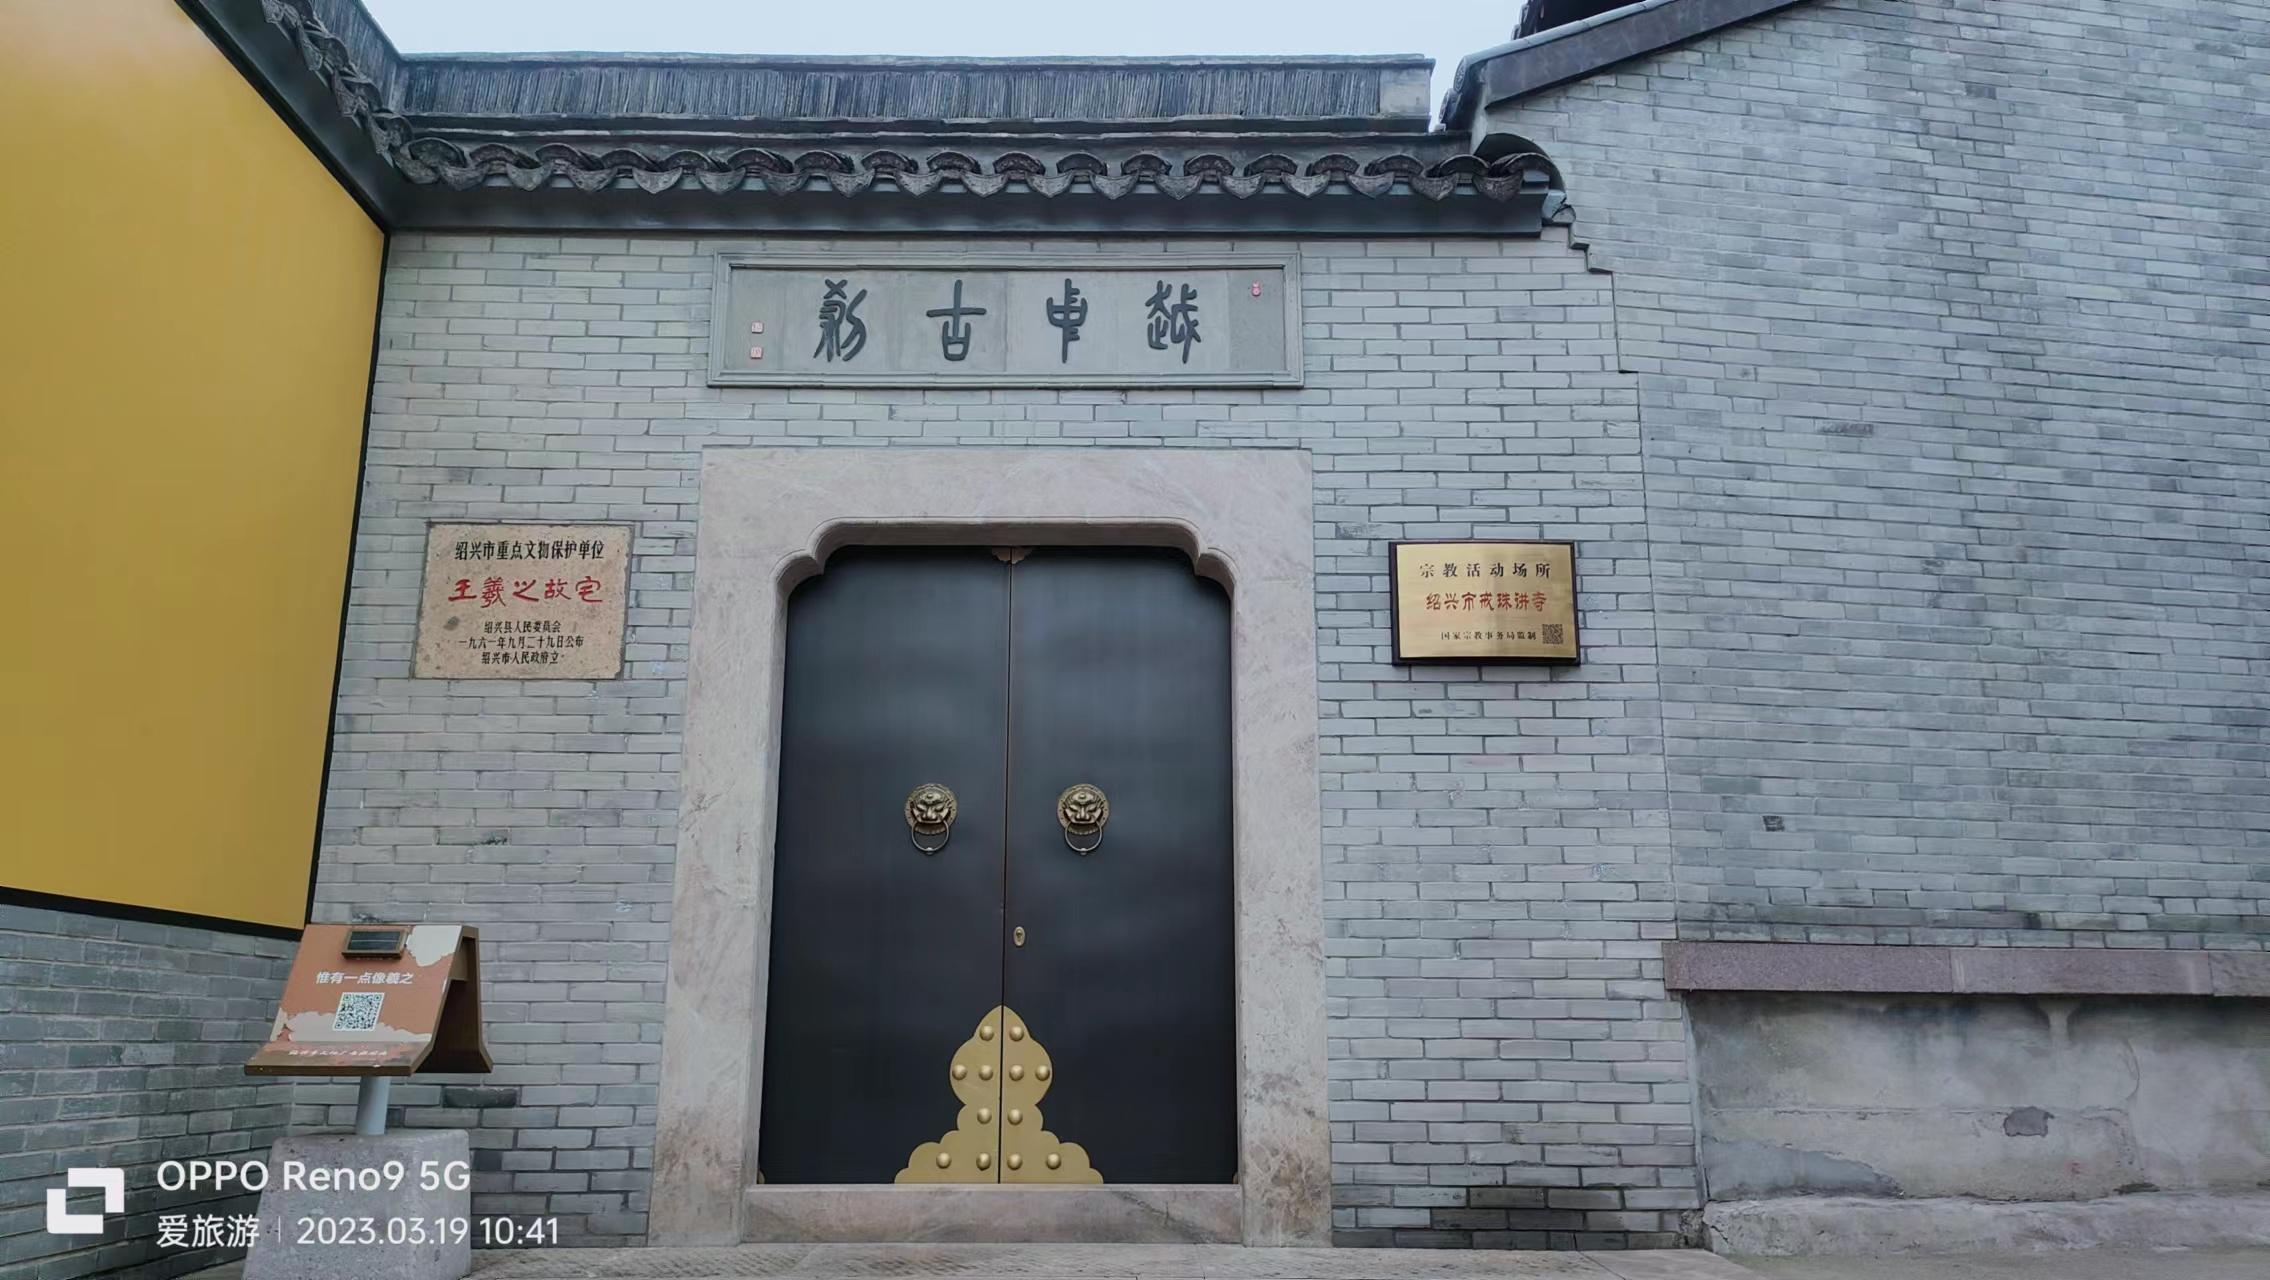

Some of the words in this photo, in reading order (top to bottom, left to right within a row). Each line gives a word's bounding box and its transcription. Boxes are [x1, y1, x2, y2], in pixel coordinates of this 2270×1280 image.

[455, 540, 604, 560] 绍兴市重点文物保护单位
[1419, 562, 1551, 578] 宗教活动场所
[448, 576, 603, 608] 王羲之故宅
[1425, 591, 1547, 612] 绍兴市戒珠讲寺
[484, 620, 561, 634] 绍兴县人民委员会
[458, 635, 584, 649] 一九六一年九月二十九日公布
[1441, 631, 1537, 641] 国家宗教事务局监制
[481, 651, 559, 665] 绍兴市人民政府立
